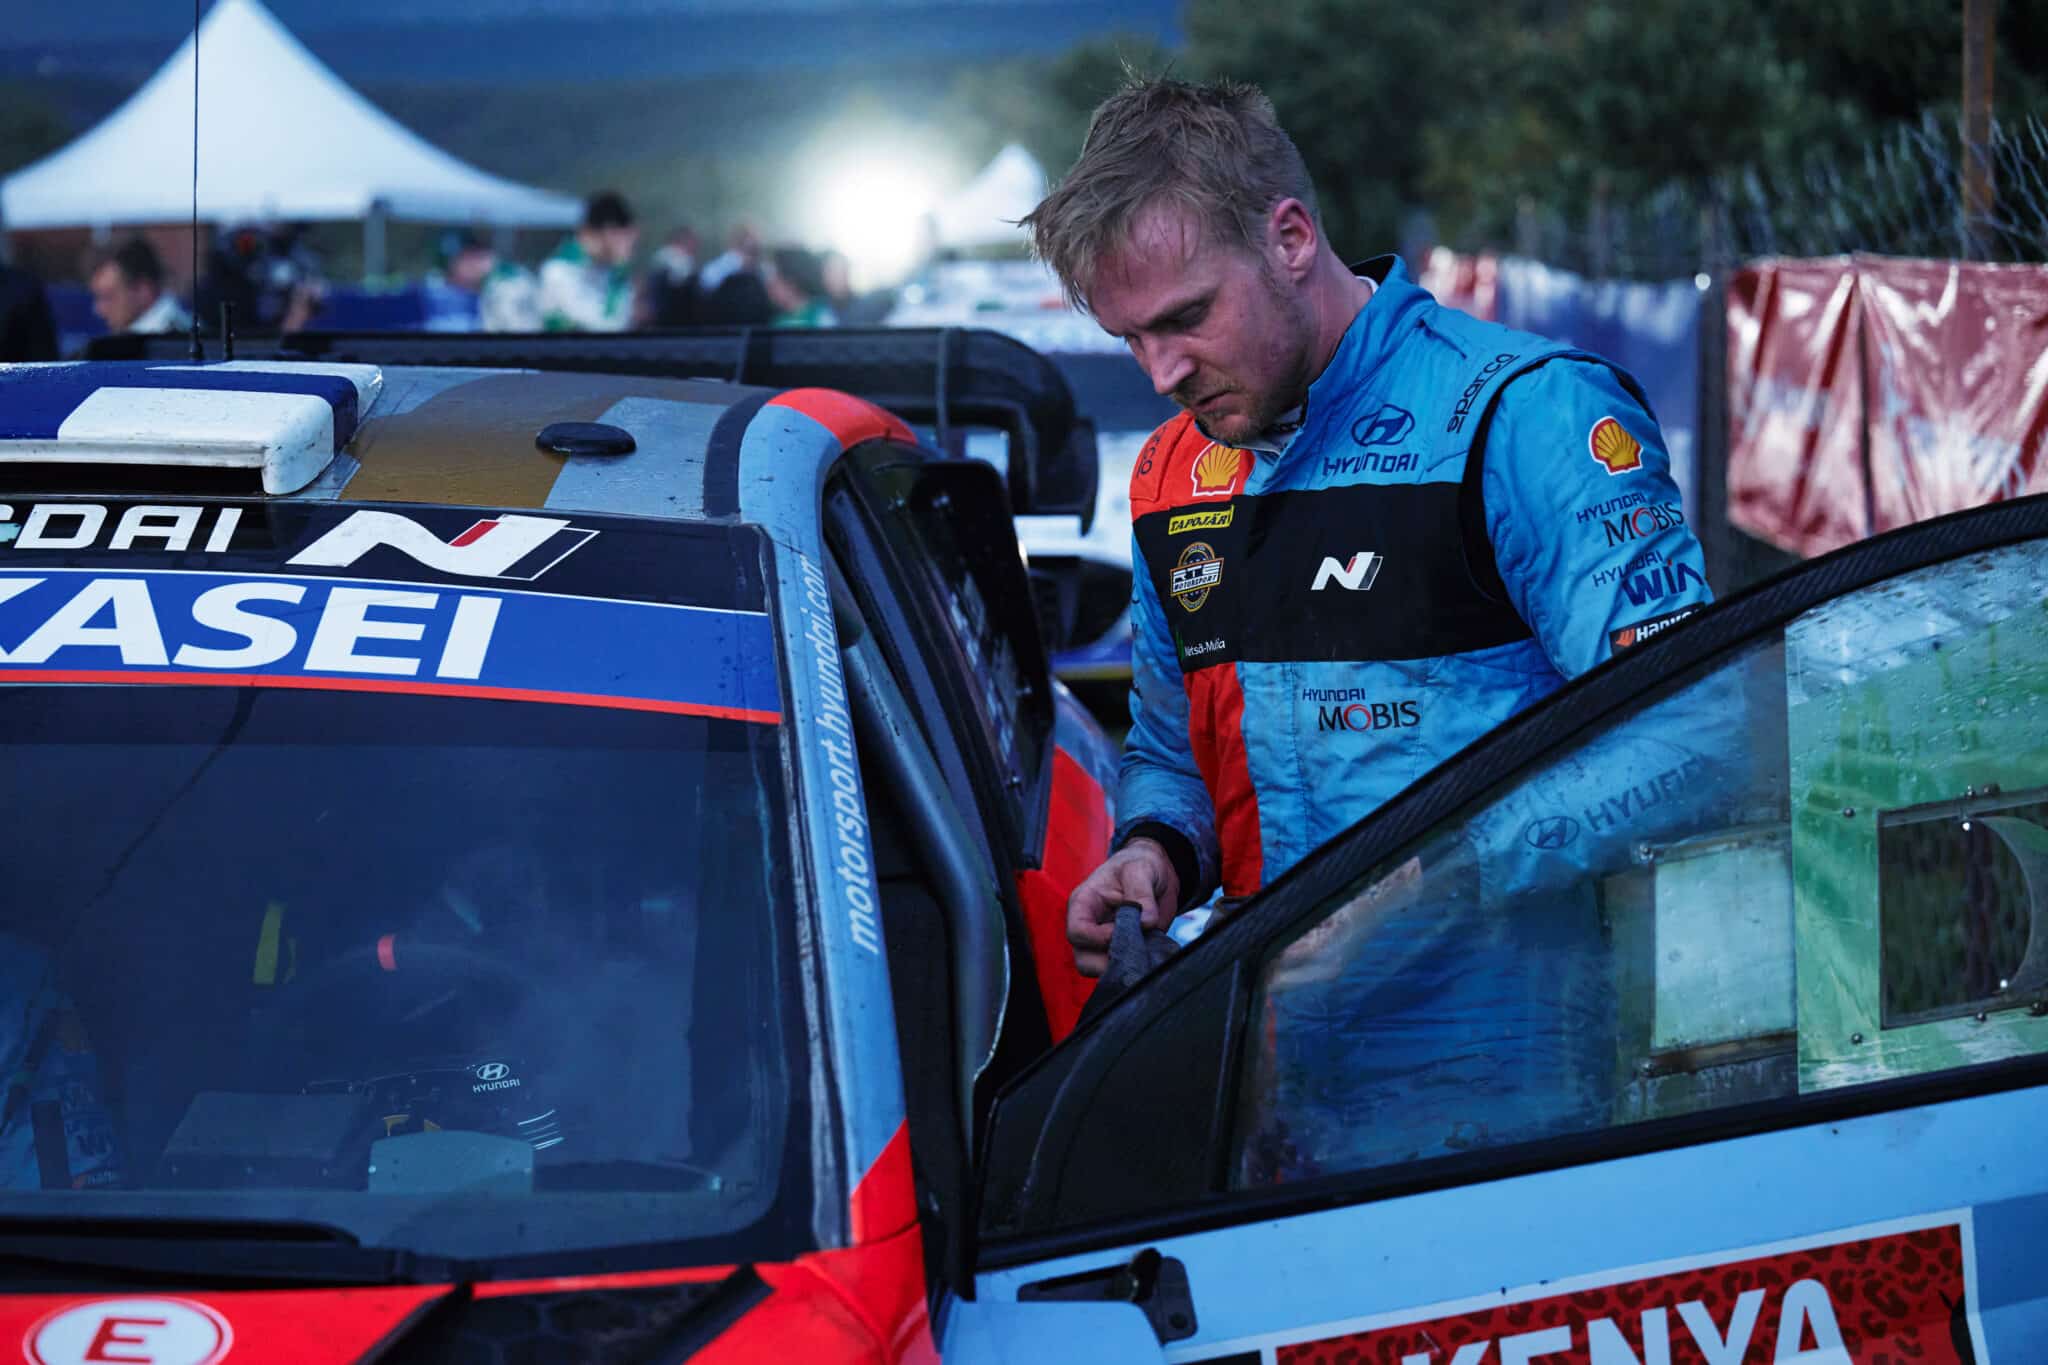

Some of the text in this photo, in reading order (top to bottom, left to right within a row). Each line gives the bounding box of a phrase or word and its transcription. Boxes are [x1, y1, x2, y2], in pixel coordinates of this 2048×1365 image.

[1447, 353, 1519, 433] sparco
[1322, 453, 1419, 476] HYUNDAI
[1576, 492, 1648, 524] HYUNDAI
[1602, 502, 1684, 547] MOBIS
[0, 503, 244, 552] DAI
[1302, 688, 1366, 701] HYUNDAI
[1318, 701, 1421, 731] MOBIS
[473, 1079, 520, 1093] HYUNDAI
[83, 1316, 167, 1362] E
[1402, 1278, 1853, 1365] NYA
